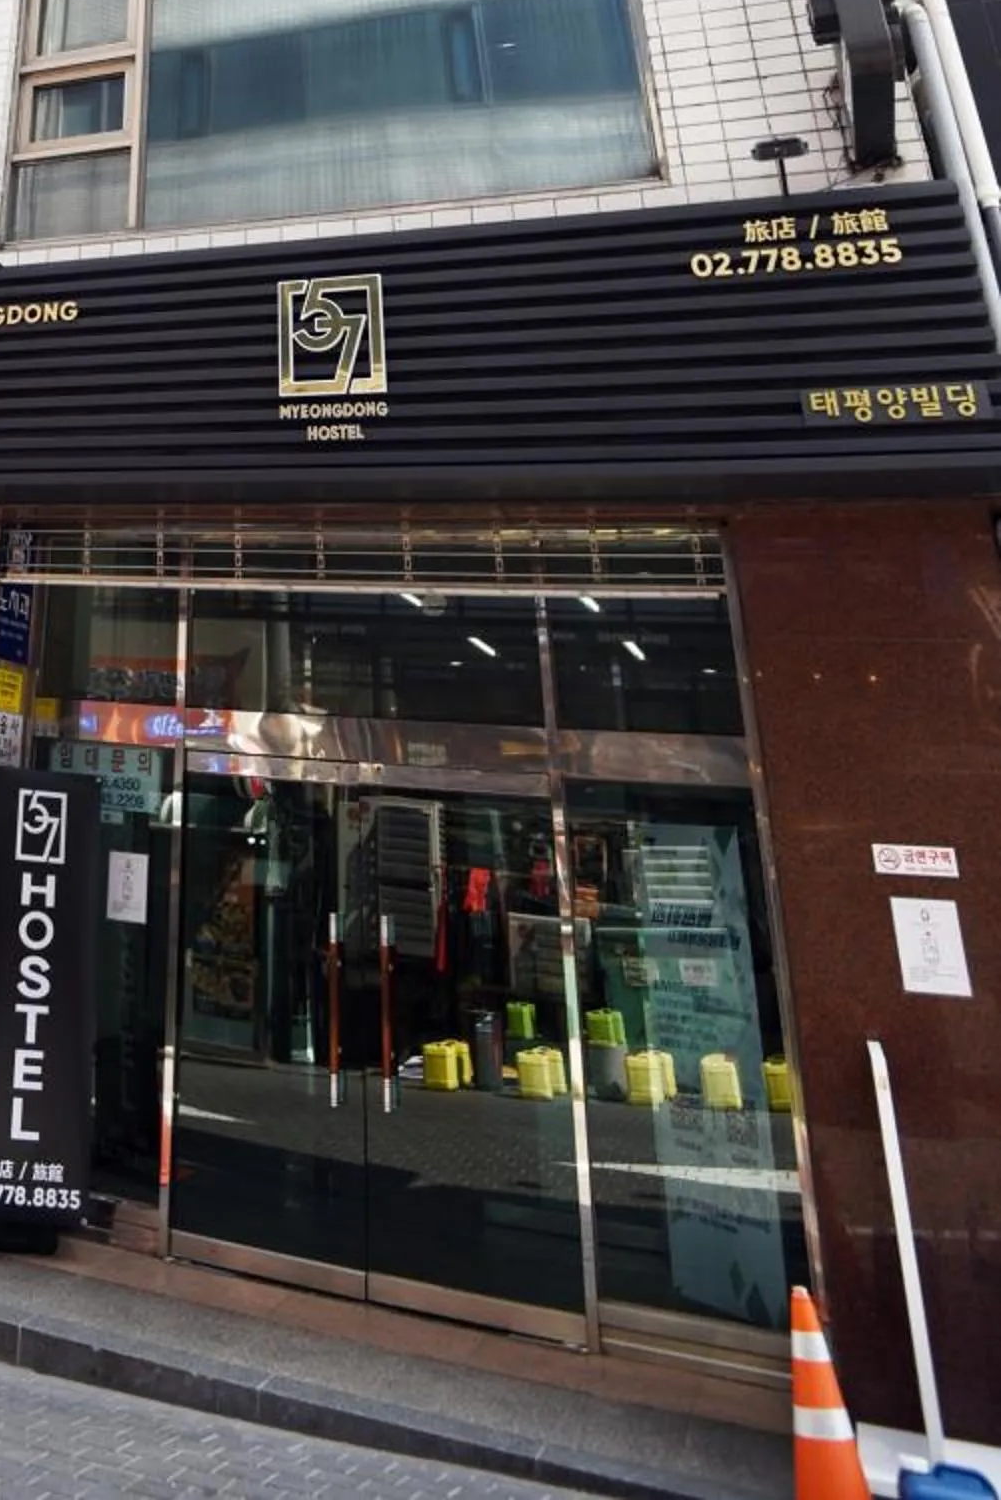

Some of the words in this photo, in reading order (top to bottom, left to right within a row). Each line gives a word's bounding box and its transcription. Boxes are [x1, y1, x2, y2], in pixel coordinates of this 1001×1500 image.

[743, 216, 797, 243] 旅店
[809, 214, 820, 240] /
[831, 208, 890, 235] 旅館
[690, 238, 903, 278] 02.778.8835
[278, 401, 390, 420] MYEONGDONG
[809, 383, 978, 423] 태평양빌딩
[307, 423, 365, 441] HOSTEL
[10, 872, 57, 1142] HOSTEL
